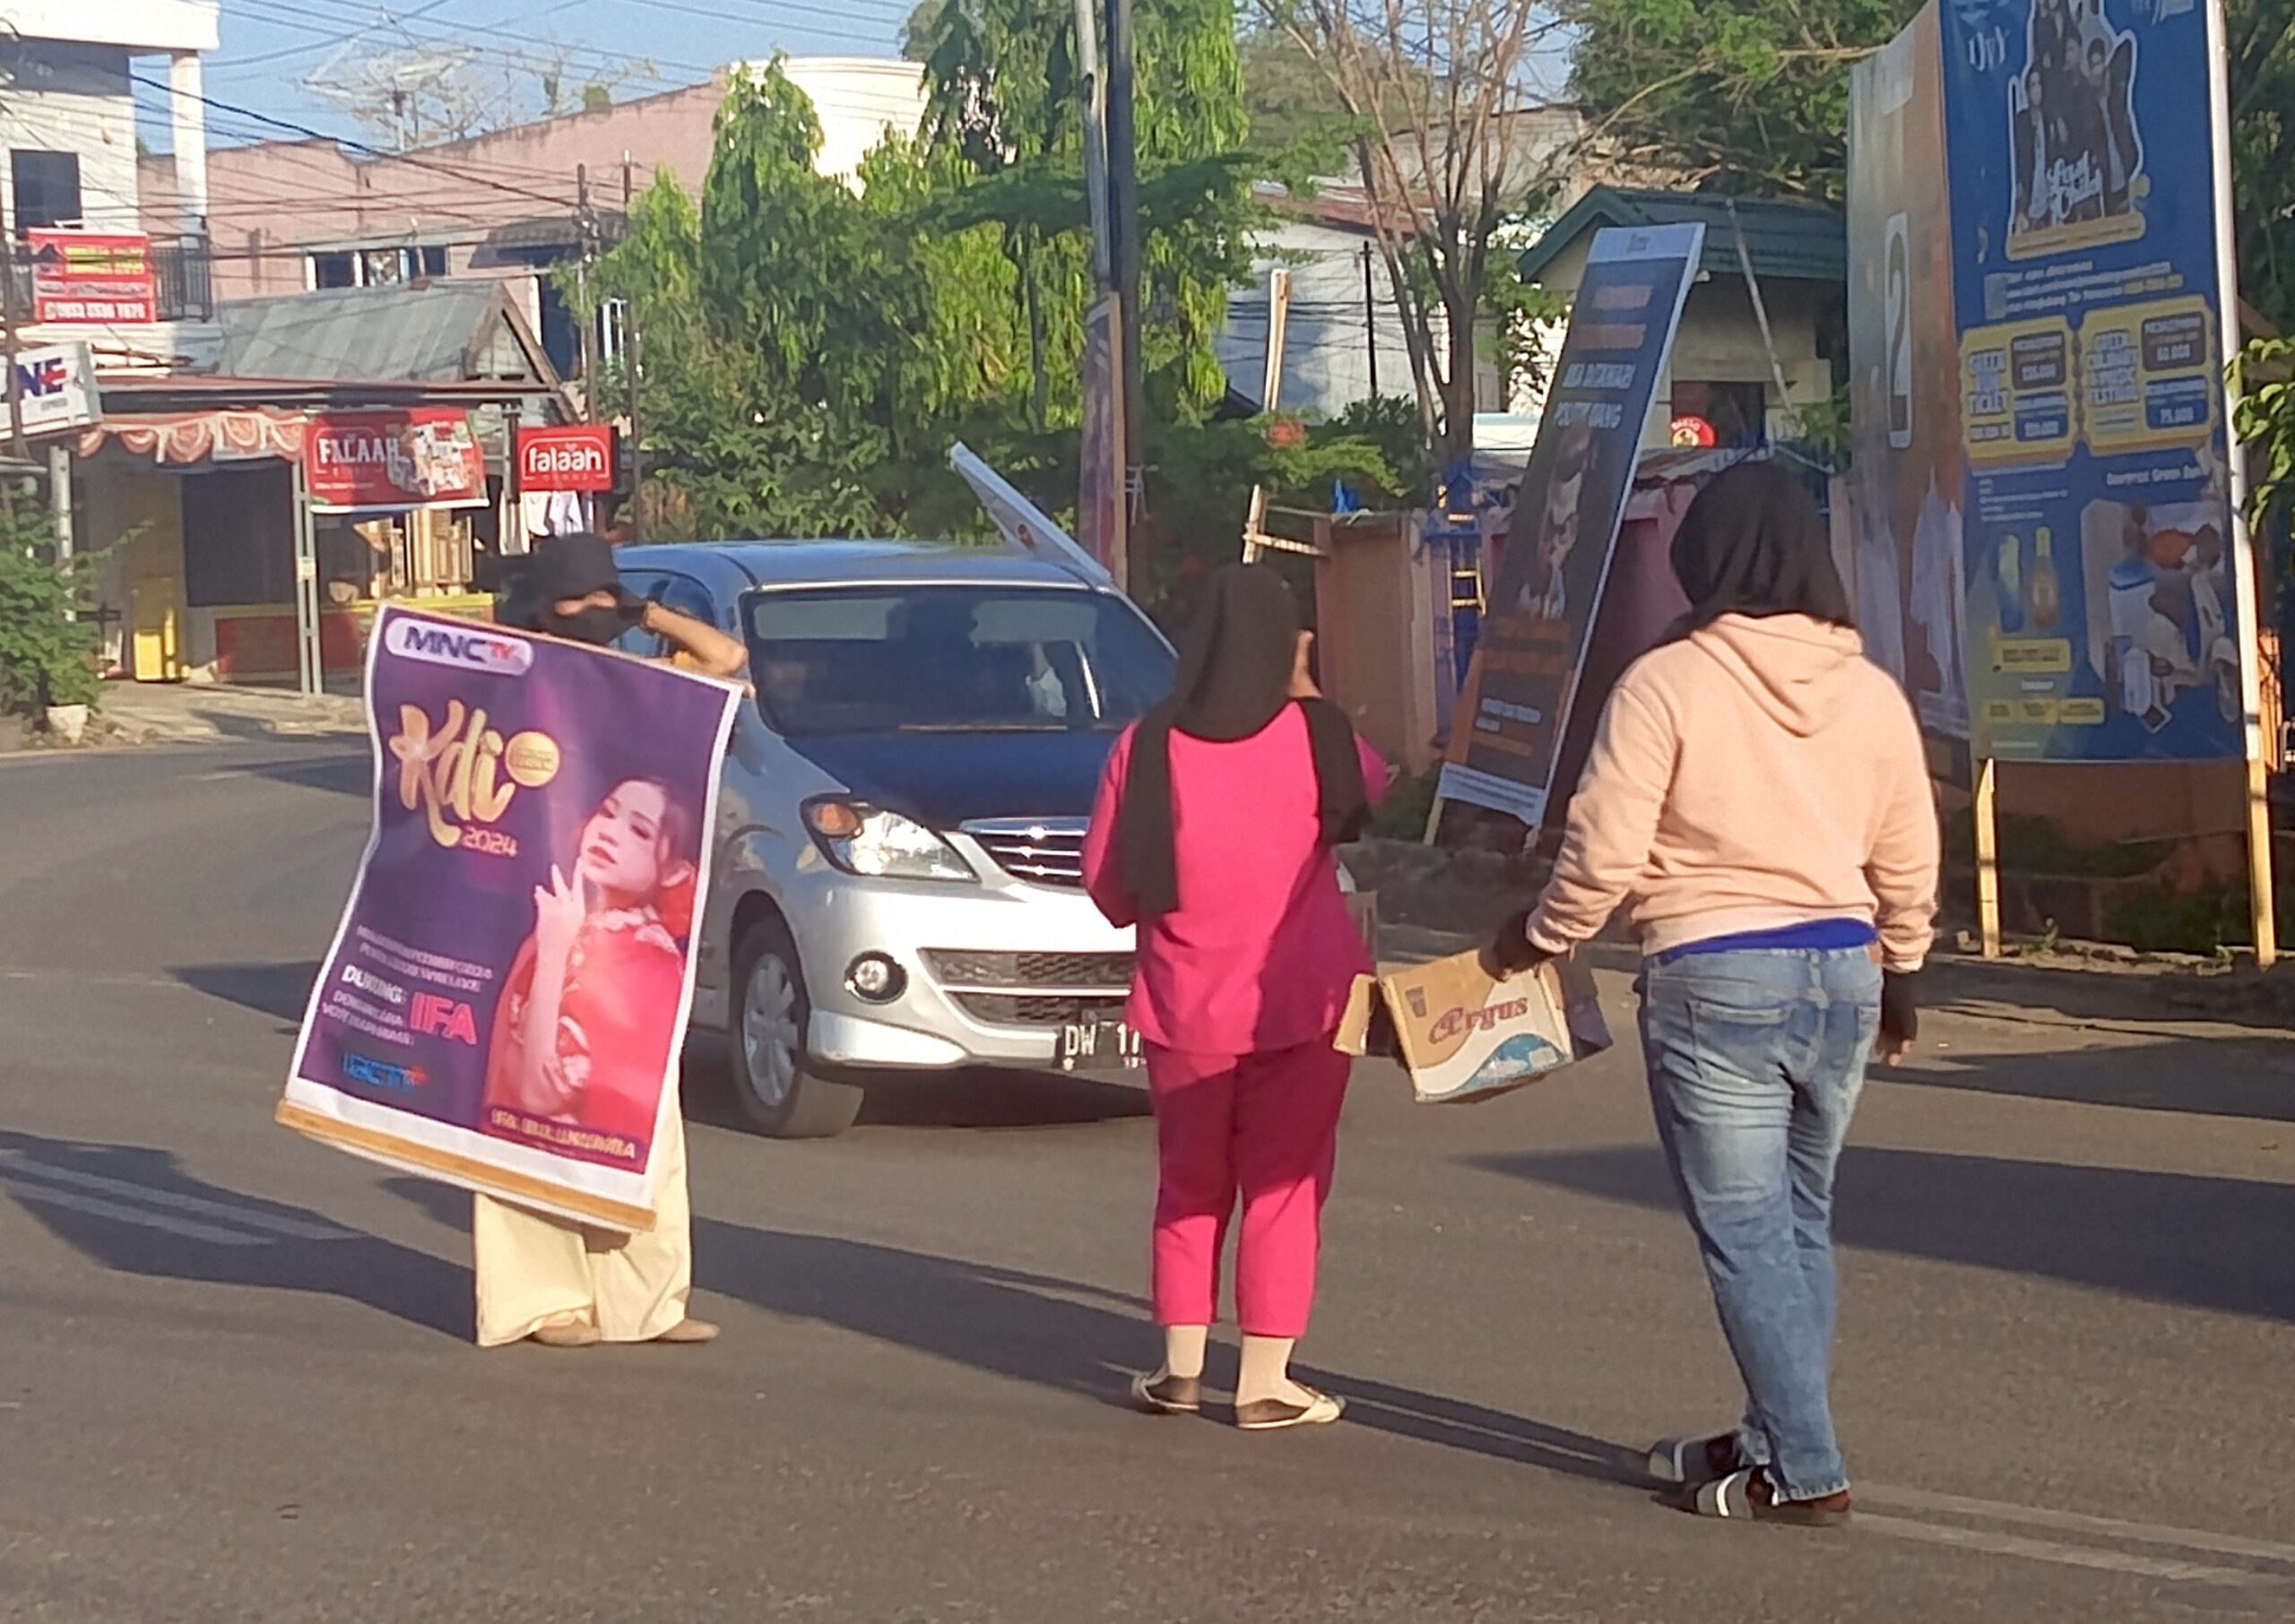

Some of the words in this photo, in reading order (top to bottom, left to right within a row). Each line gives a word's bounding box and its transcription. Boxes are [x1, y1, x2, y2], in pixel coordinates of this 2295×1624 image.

[529, 446, 602, 473] falaah
[460, 825, 519, 858] 2024
[410, 990, 478, 1046] IFA
[1064, 1024, 1096, 1057] DW
